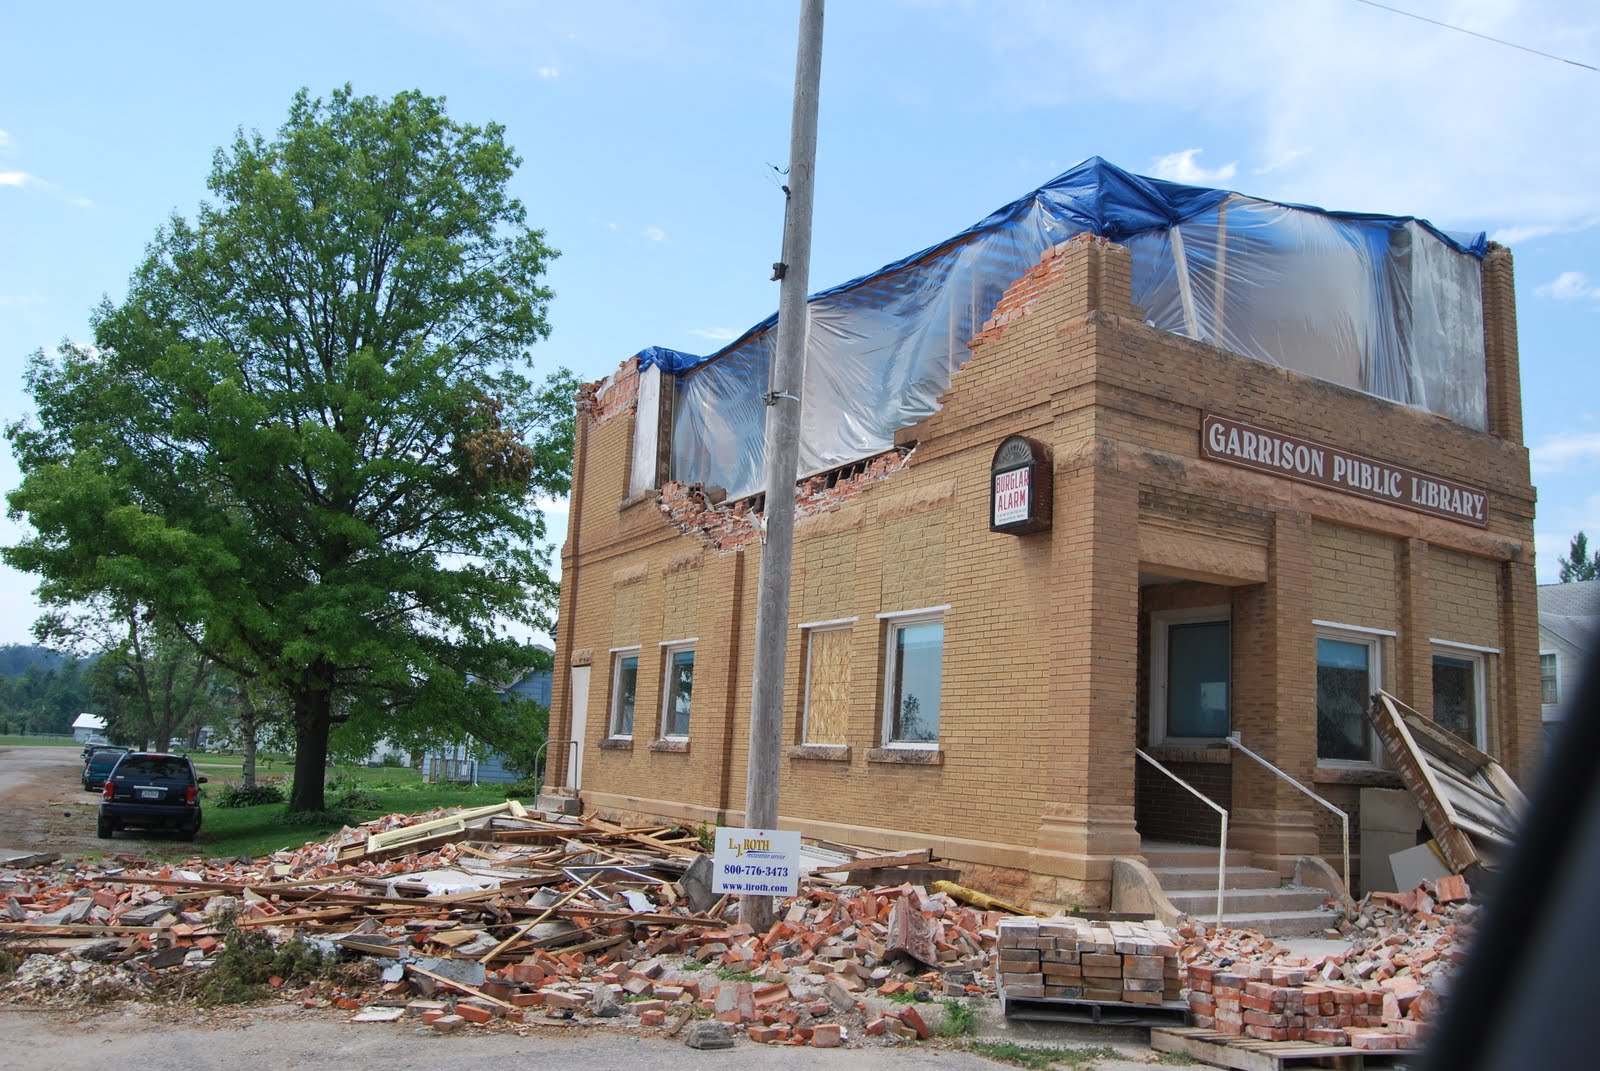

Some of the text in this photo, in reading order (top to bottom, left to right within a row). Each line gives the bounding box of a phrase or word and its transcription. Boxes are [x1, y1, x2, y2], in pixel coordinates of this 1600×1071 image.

[1209, 423, 1485, 520] GARRISON PUBLIC LIBRARY
[996, 470, 1029, 493] BURGLAR
[998, 489, 1026, 511] ALARM
[744, 839, 769, 851] ROTH
[724, 864, 789, 877] 800-776-3473
[722, 883, 788, 893] www.ljroth.com
